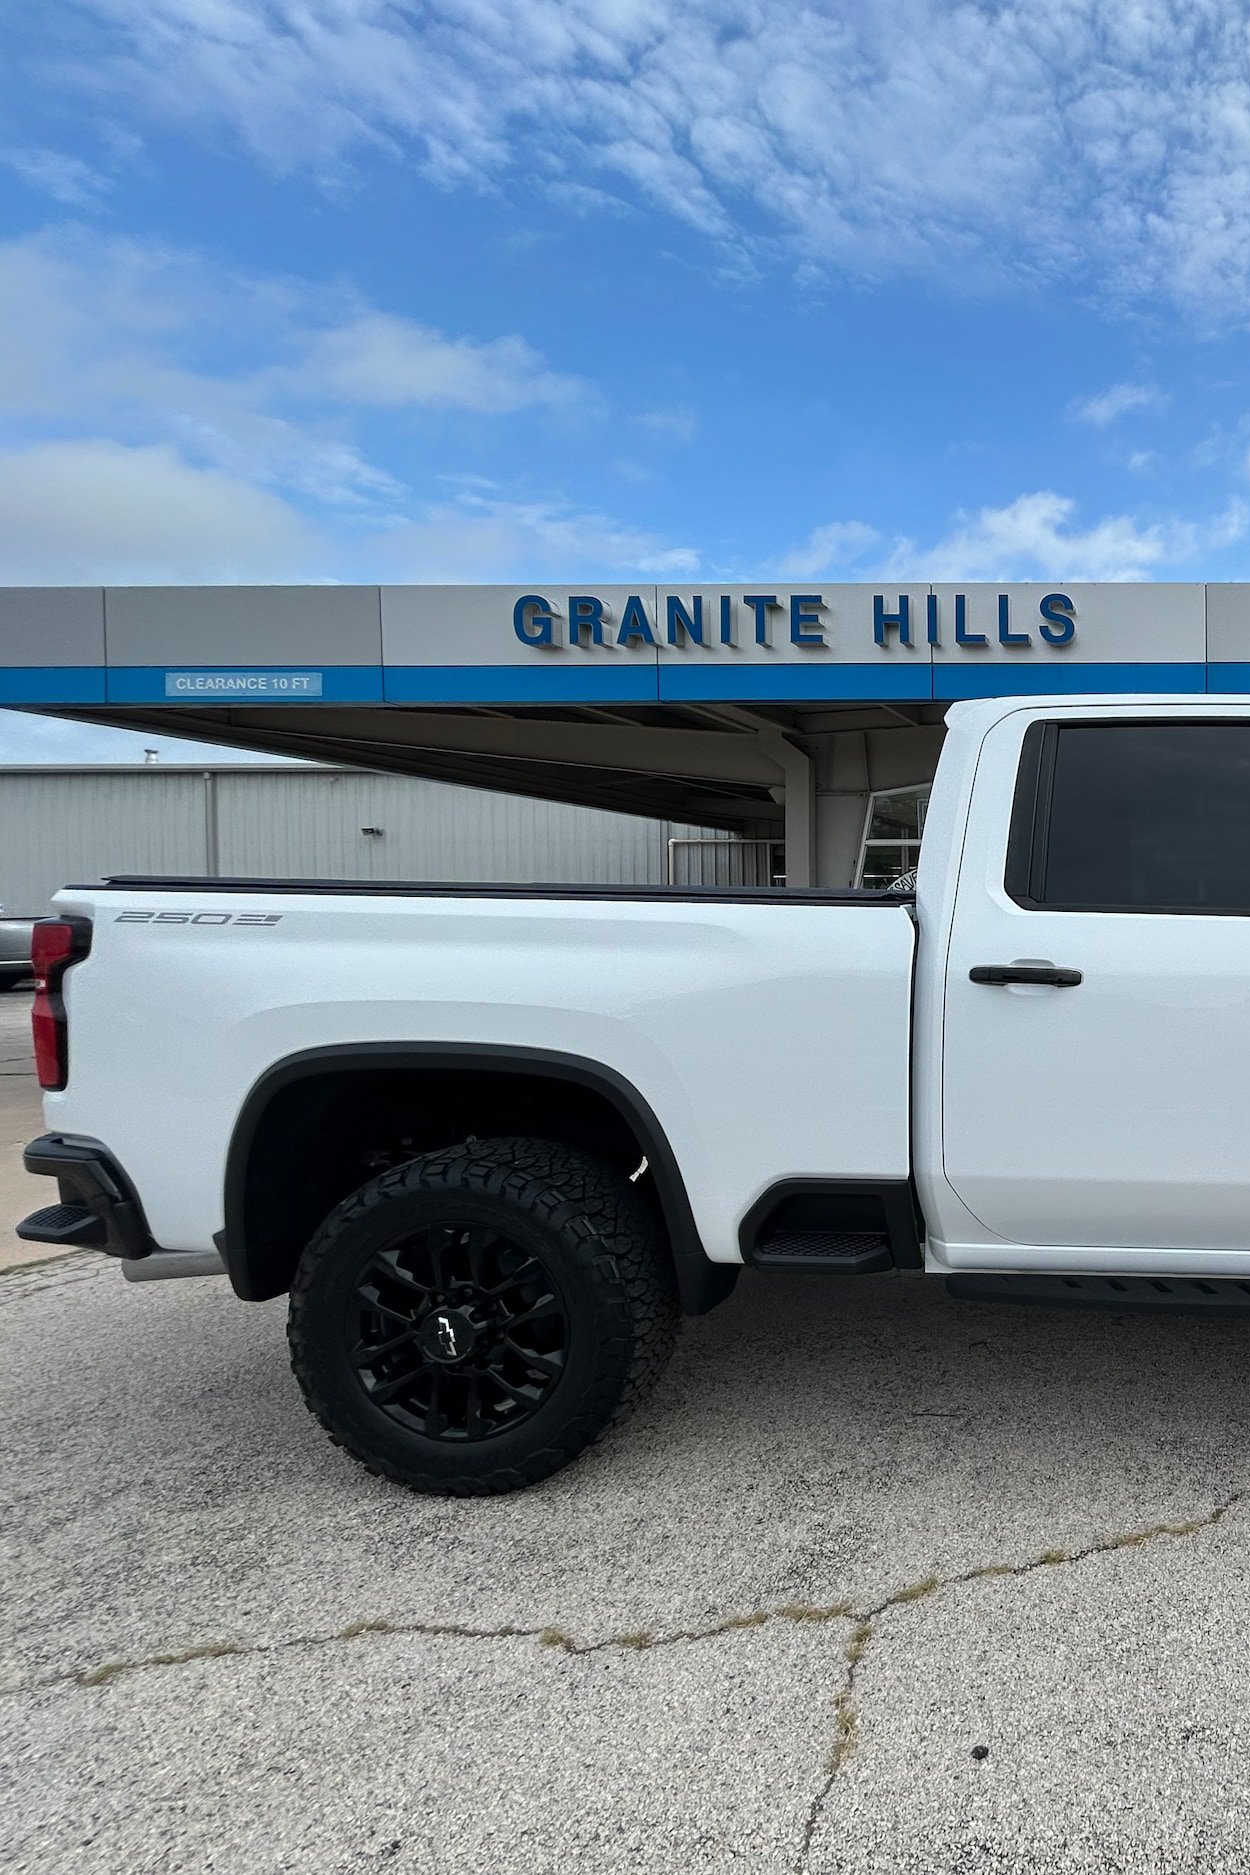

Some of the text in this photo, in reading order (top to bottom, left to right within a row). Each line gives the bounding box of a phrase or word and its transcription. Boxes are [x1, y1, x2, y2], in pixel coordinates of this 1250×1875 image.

[512, 592, 1077, 648] GRANITE HILLS
[176, 677, 310, 690] CLEARANCE 10 FT
